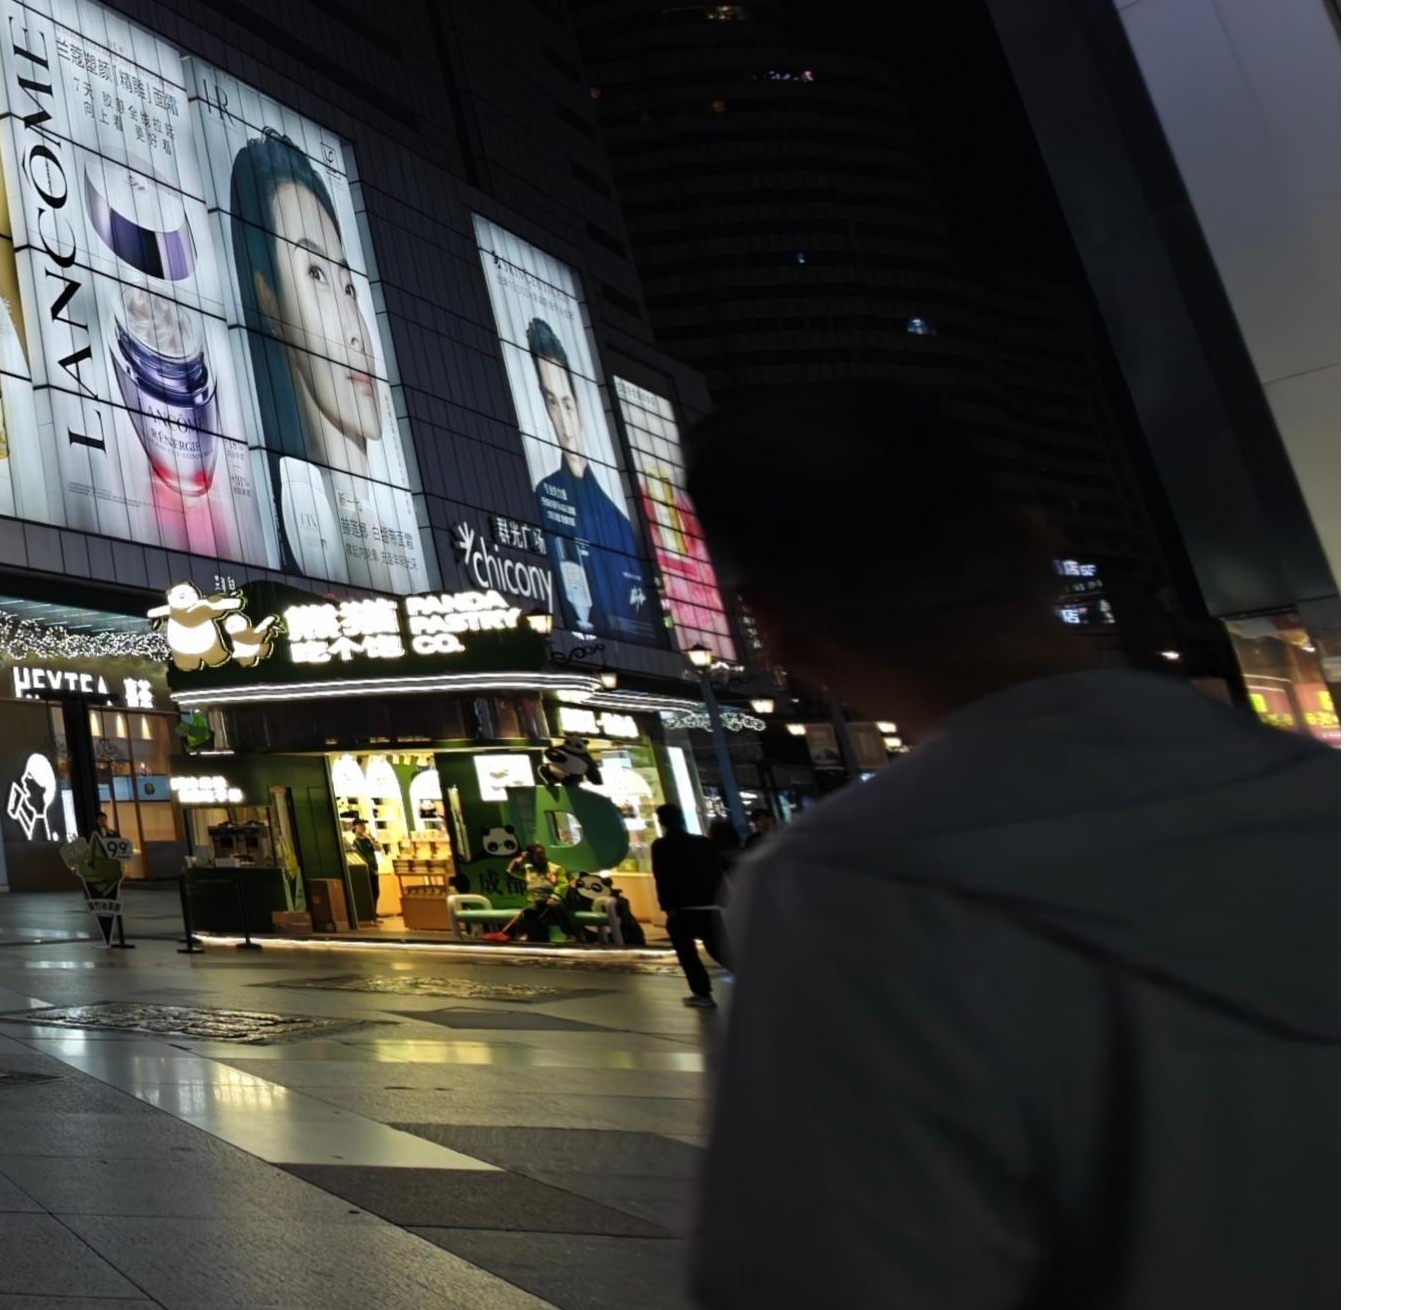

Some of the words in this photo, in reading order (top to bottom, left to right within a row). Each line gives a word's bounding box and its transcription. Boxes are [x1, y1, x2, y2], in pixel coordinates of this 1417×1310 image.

[7, 14, 107, 457] LANCÔME
[496, 517, 547, 555] 群光广场
[473, 536, 553, 614] chicony
[405, 590, 510, 615] PANDA
[409, 607, 522, 635] PASTRY
